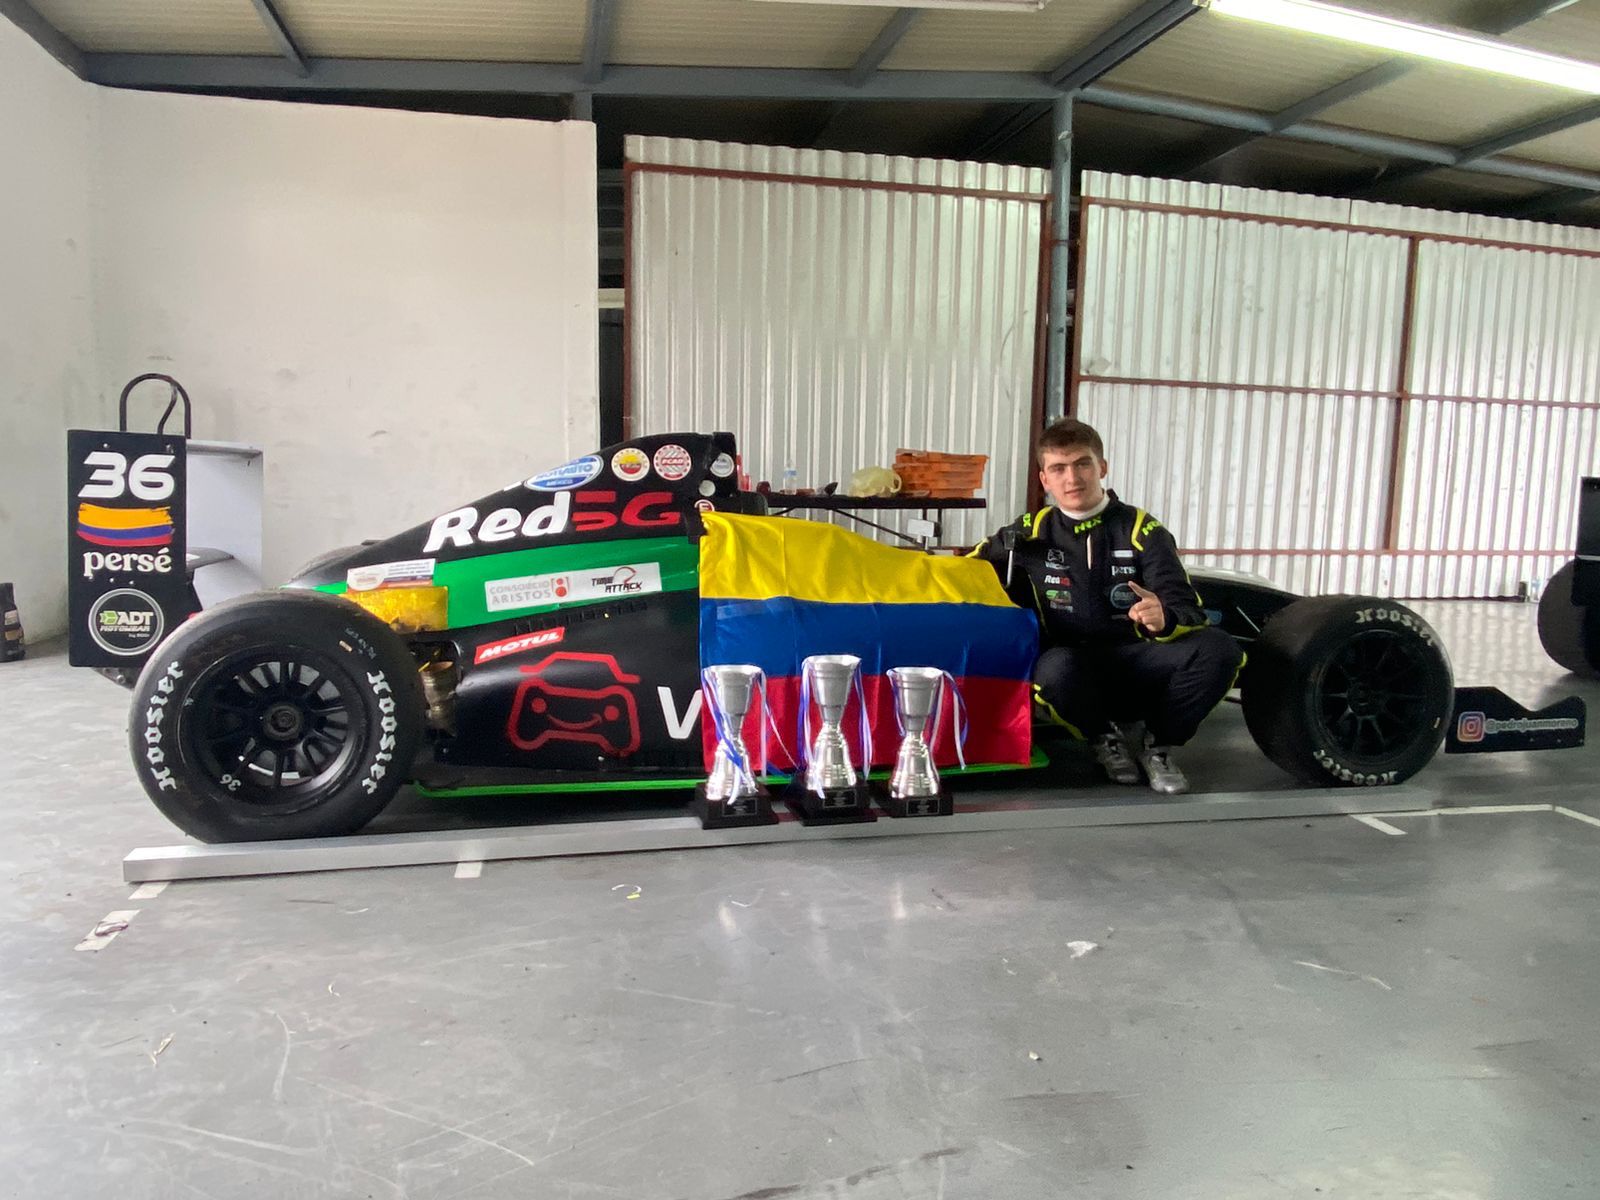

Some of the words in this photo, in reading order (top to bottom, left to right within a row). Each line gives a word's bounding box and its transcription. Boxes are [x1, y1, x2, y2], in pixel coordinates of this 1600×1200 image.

[78, 451, 175, 501] 36
[83, 547, 172, 577] persé
[591, 576, 614, 587] TIME
[605, 581, 643, 594] ATTACK
[491, 589, 552, 606] ARISTOS
[117, 611, 154, 626] ADT
[479, 631, 560, 660] MOTUL
[144, 661, 184, 792] Hoosier
[362, 670, 398, 795] Hoosier
